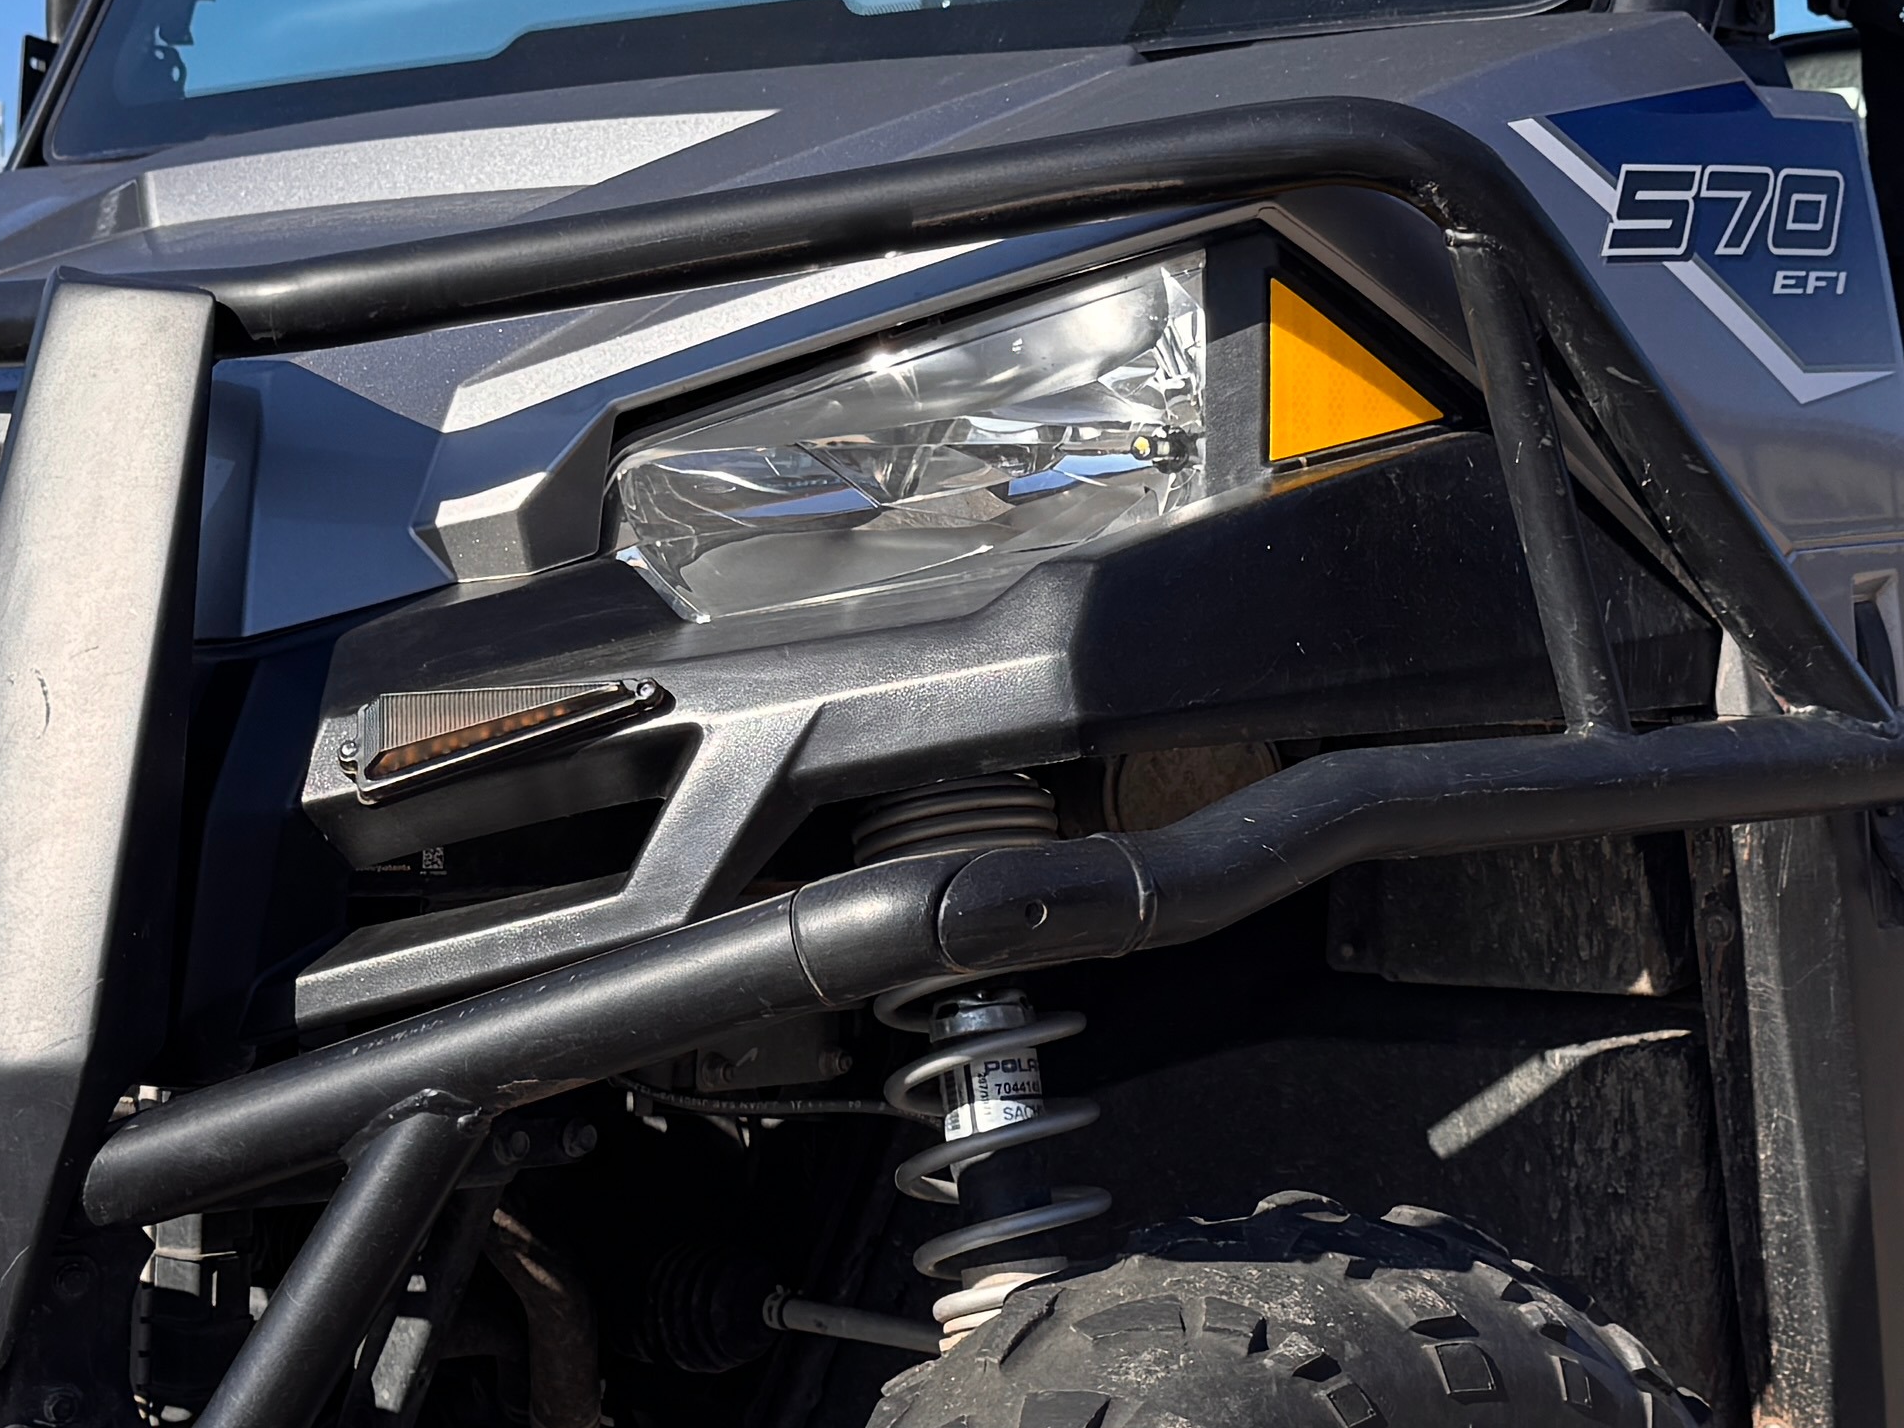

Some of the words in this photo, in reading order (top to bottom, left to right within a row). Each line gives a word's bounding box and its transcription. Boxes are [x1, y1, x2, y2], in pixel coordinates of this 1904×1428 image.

[1601, 163, 1845, 262] 570
[1772, 270, 1847, 295] EFI
[984, 1058, 1037, 1077] POLA
